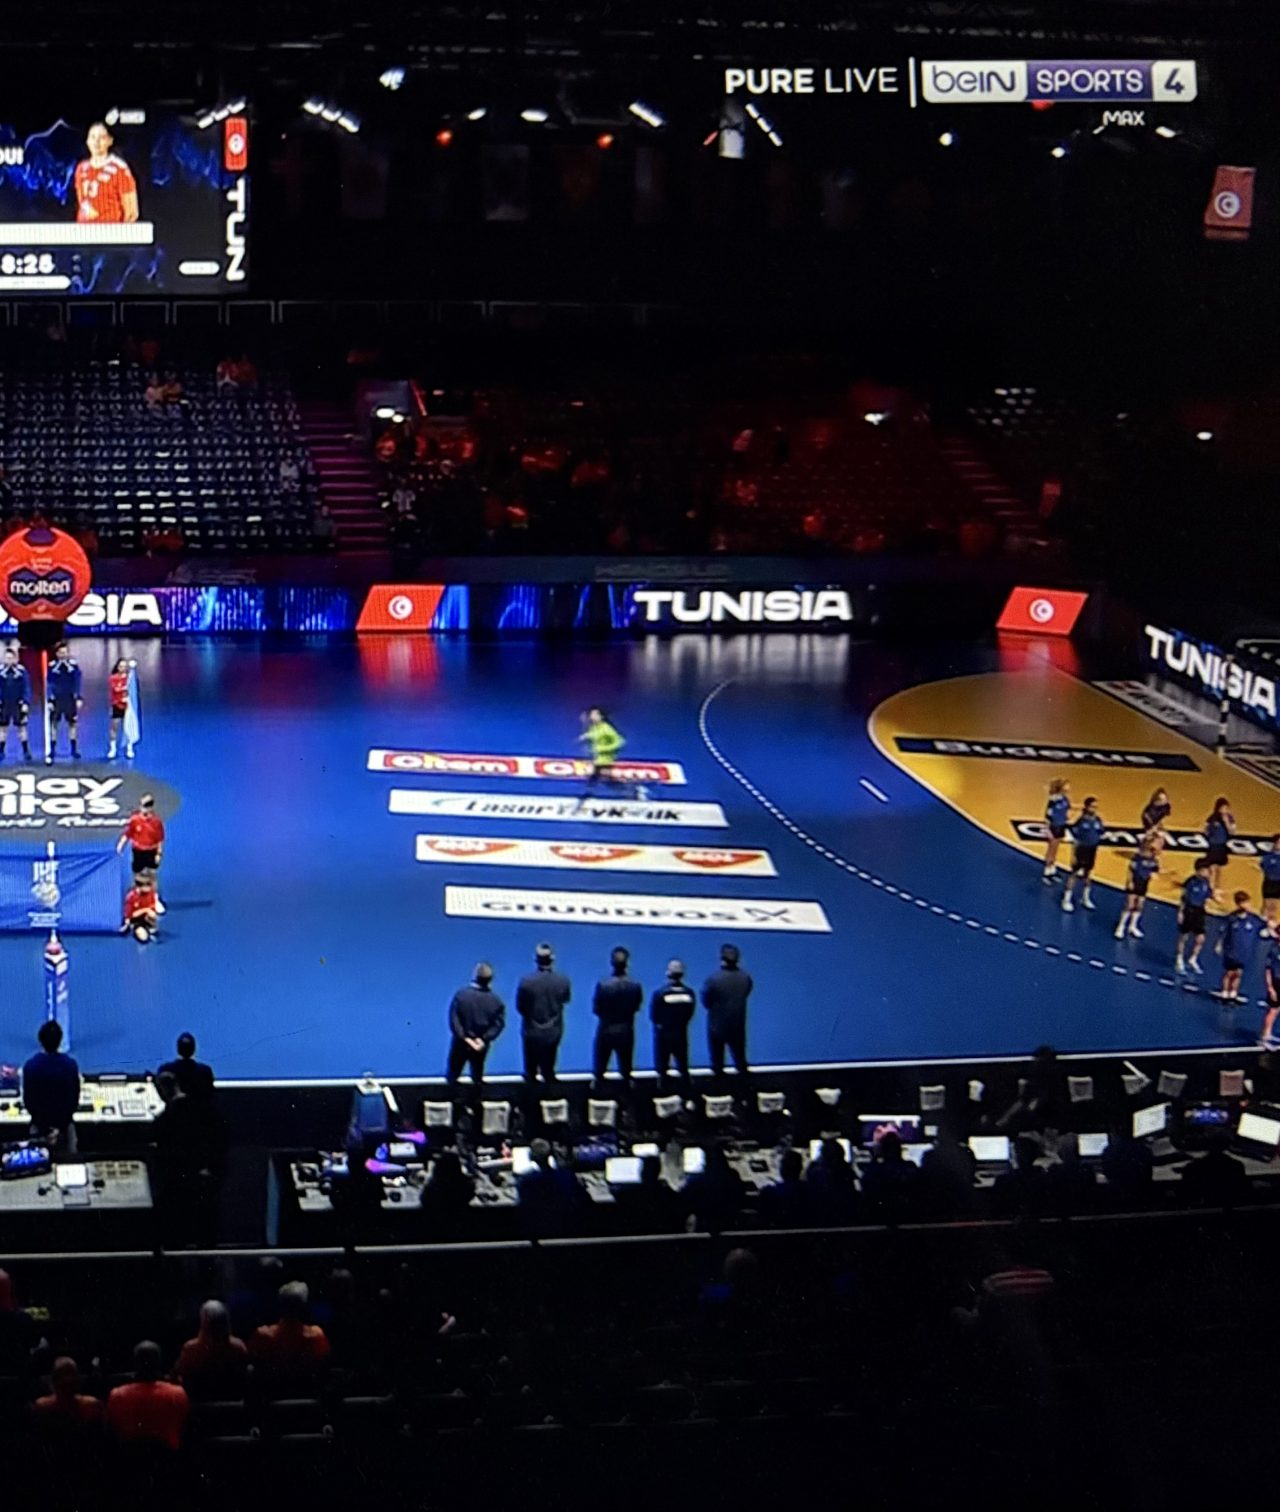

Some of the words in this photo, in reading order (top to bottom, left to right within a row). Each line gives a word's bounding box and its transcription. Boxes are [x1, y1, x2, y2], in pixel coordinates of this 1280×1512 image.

[10, 580, 71, 596] molten
[634, 590, 853, 621] TUNISIA
[1145, 624, 1277, 717] TUNISIA
[482, 899, 738, 923] GRUNDFOS
